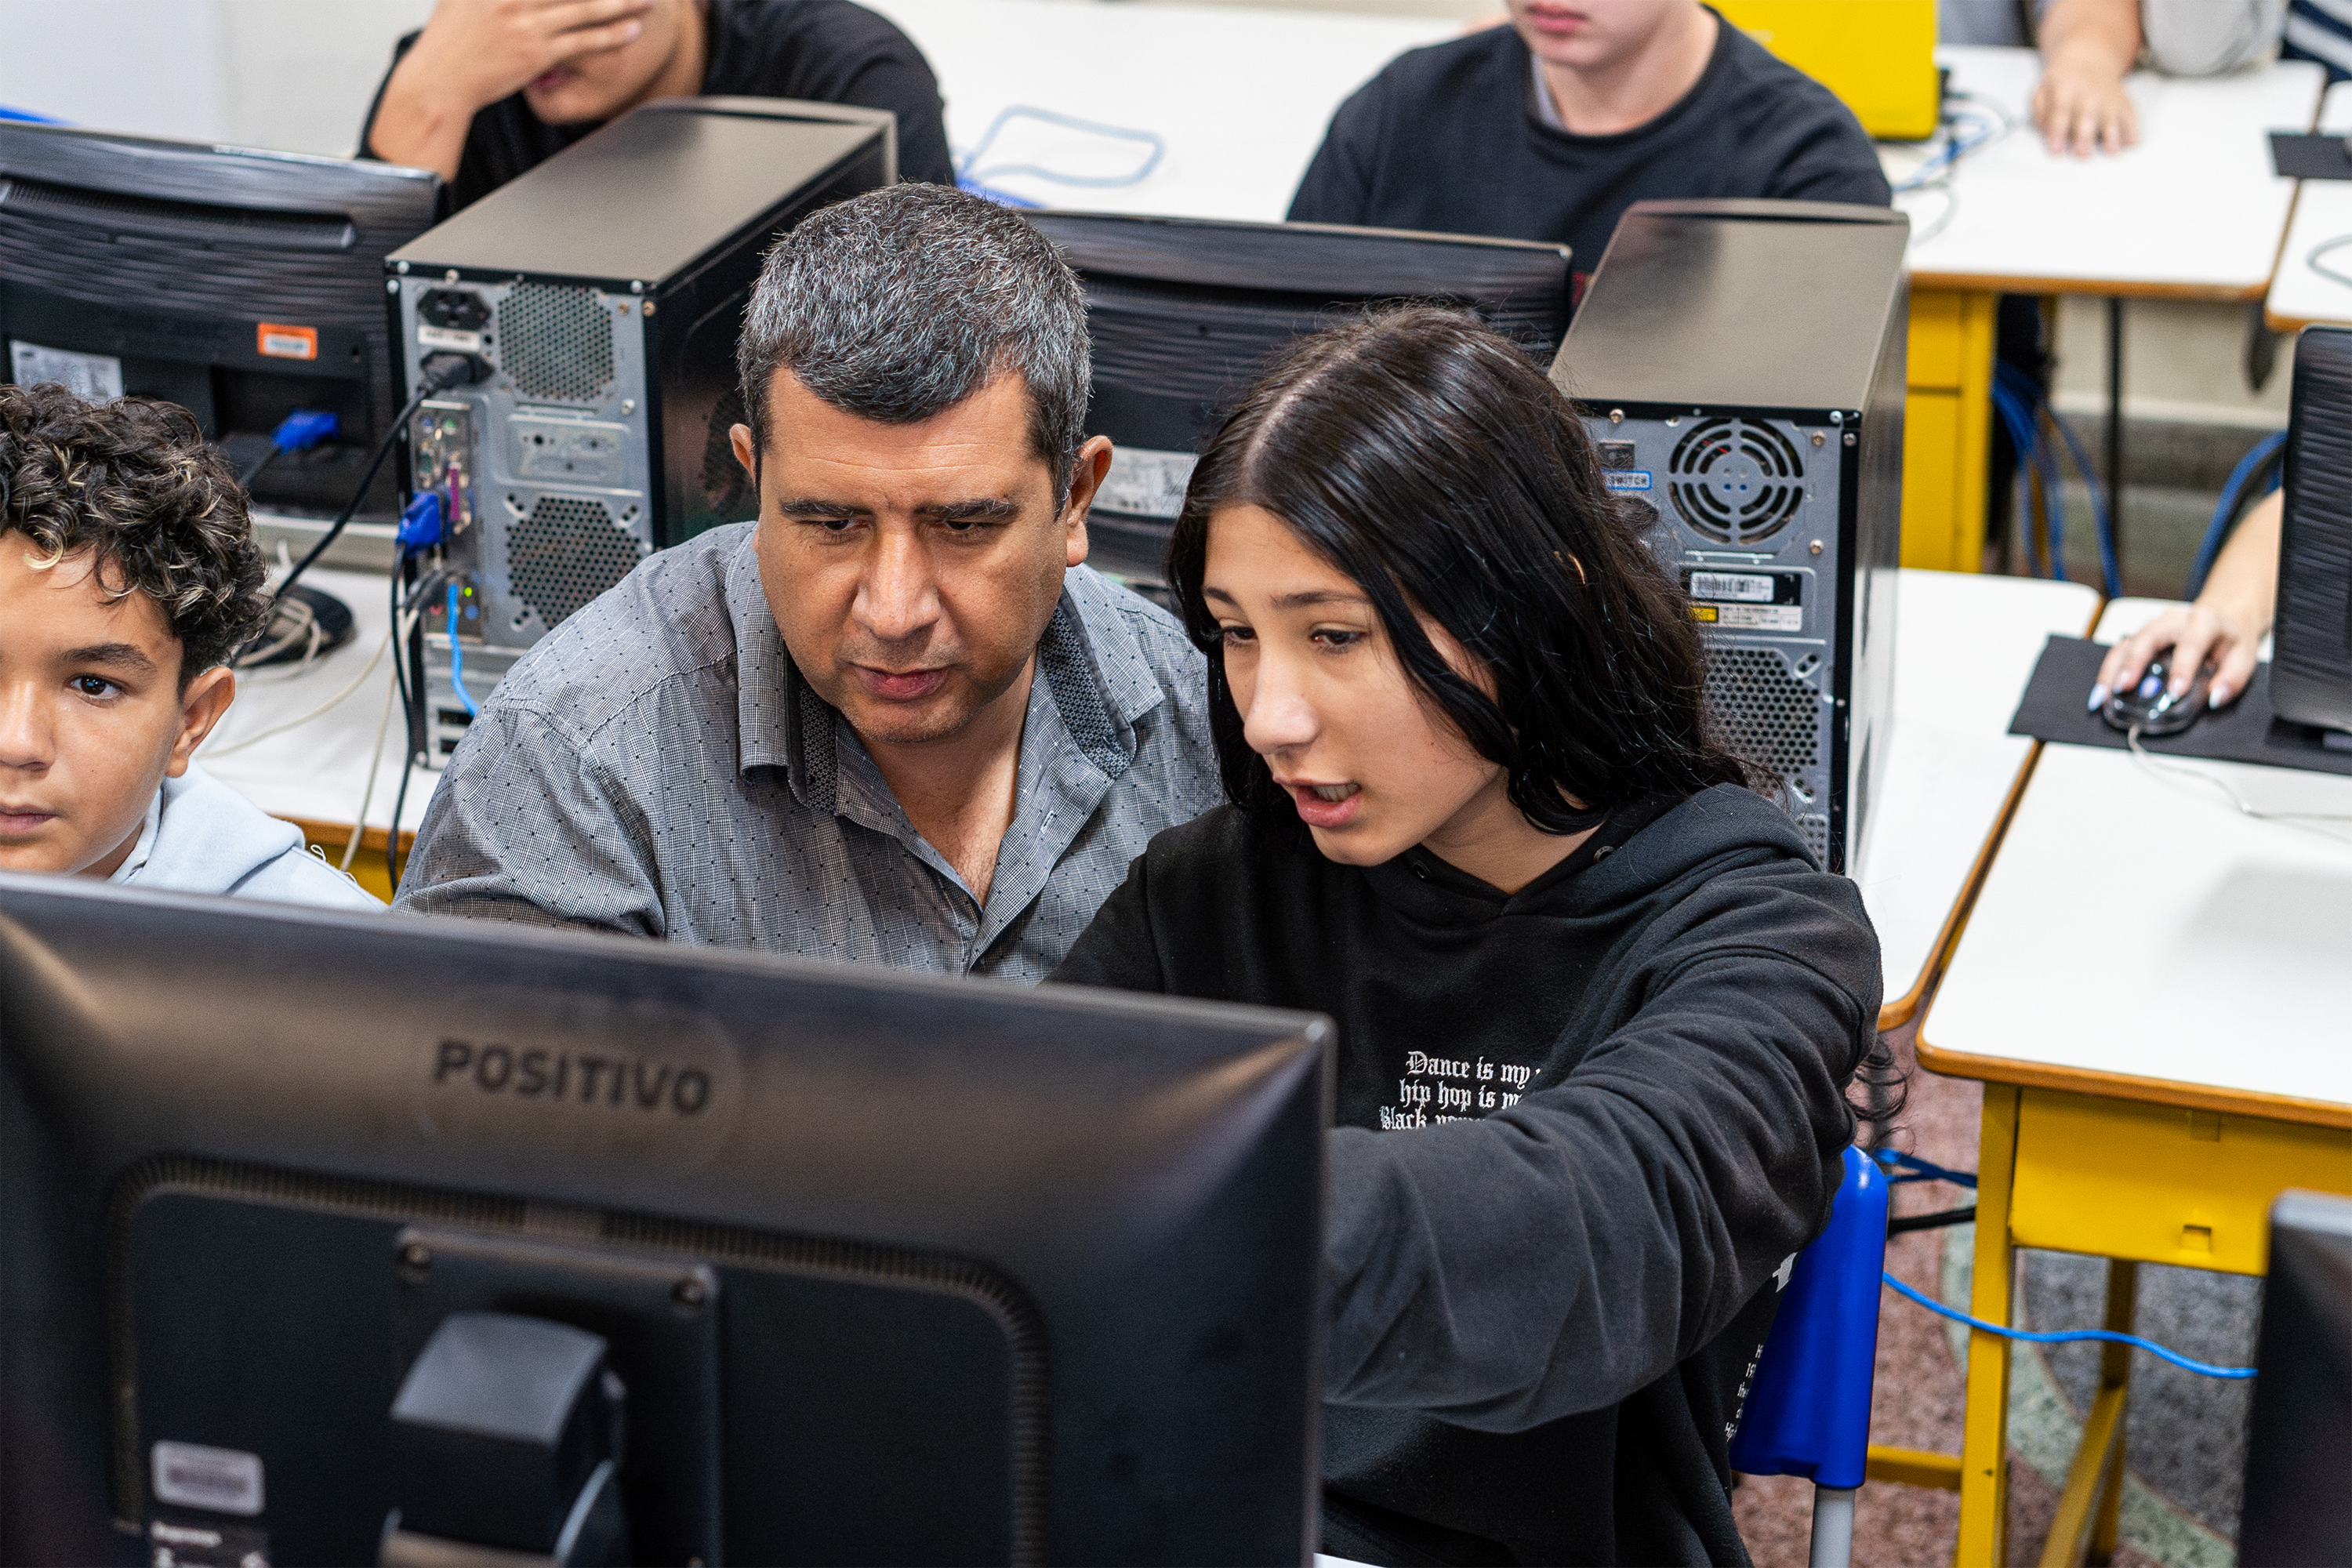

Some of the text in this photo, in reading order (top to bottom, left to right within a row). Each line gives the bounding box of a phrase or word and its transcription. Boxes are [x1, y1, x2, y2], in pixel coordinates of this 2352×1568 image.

[434, 1040, 710, 1116] POSITIVO
[1406, 1051, 1530, 1091] Dance is my
[1399, 1078, 1523, 1112] hip hop is m
[1379, 1105, 1428, 1131] Black
